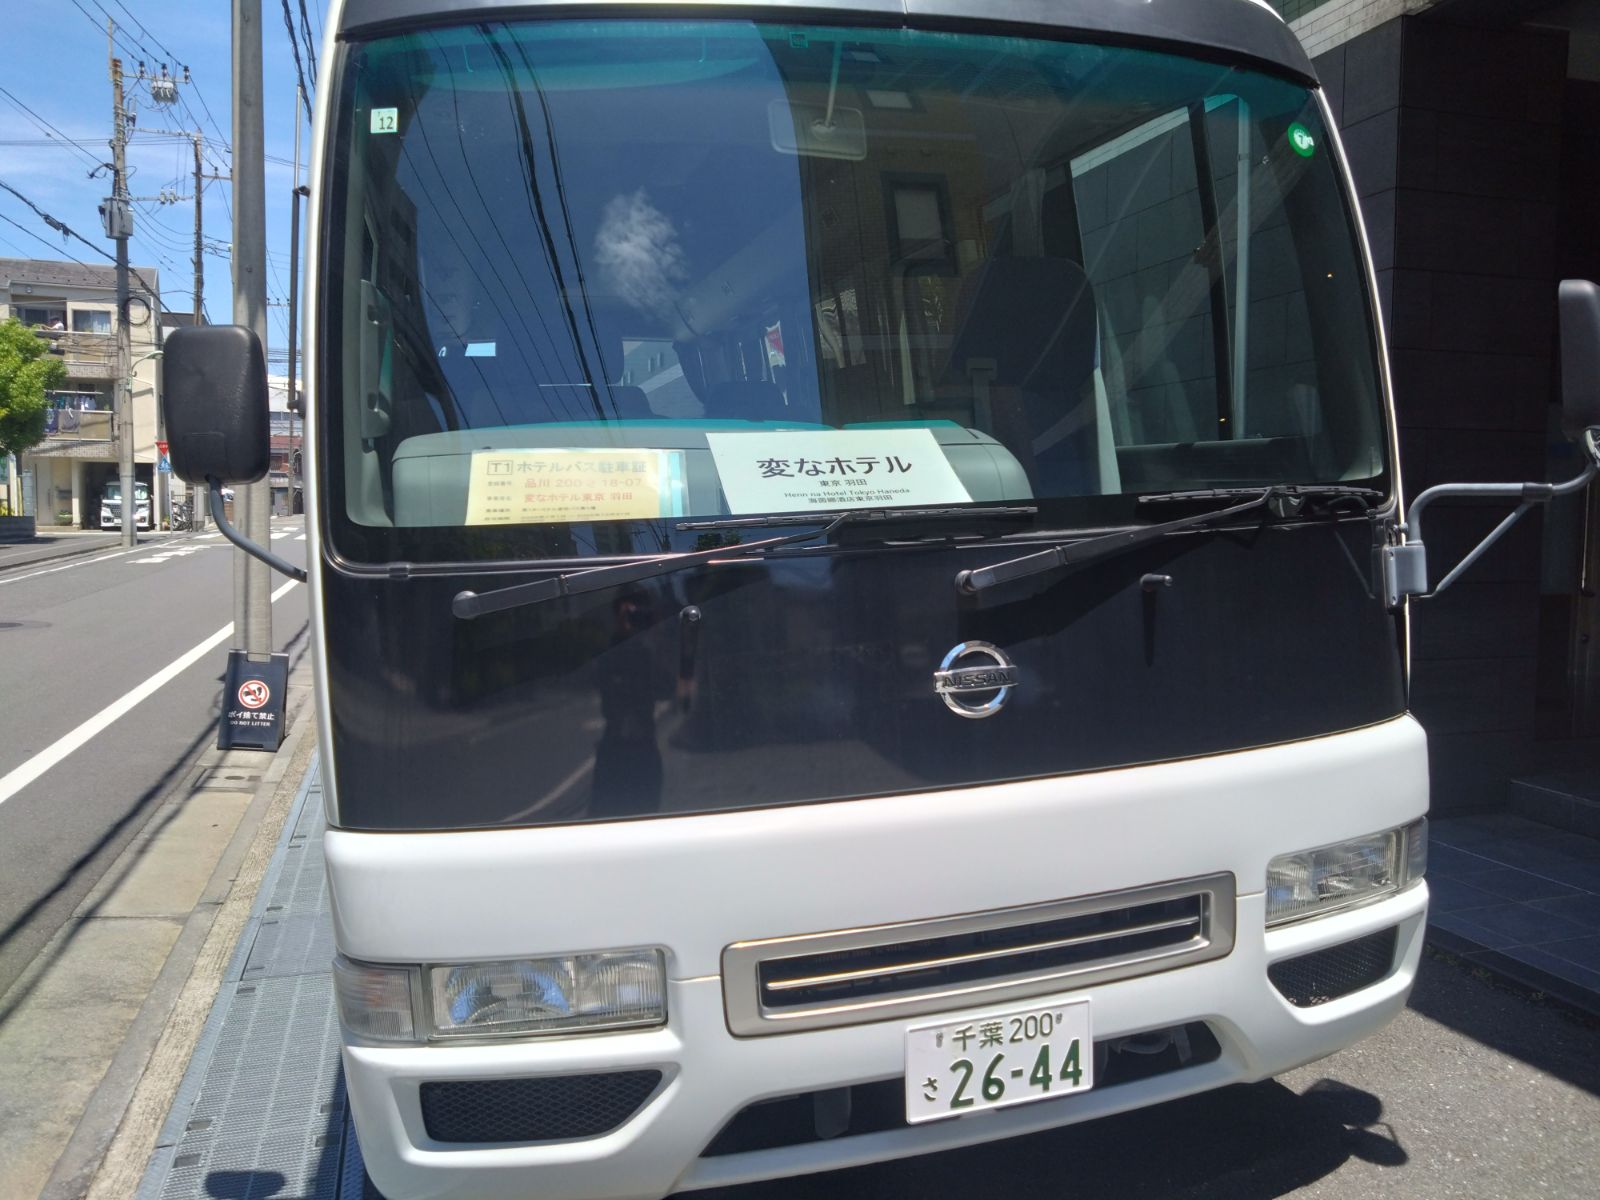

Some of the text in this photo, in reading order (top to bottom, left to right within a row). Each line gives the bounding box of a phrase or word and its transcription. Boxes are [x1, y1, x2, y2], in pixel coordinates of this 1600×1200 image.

[379, 116, 394, 130] 12
[491, 461, 647, 474] T1 ホテルバス駐車証
[756, 456, 912, 478] 変なホテル
[525, 478, 550, 488] 品川
[555, 478, 582, 488] 200
[602, 478, 643, 488] 18-07
[820, 479, 868, 488] 東京 羽田
[524, 493, 605, 503] 変なホテル東京
[943, 671, 1009, 688] NISSAN
[228, 711, 275, 720] ポイ捨て禁止
[952, 1012, 1053, 1051] 千葉 200
[922, 1038, 1083, 1109] さ 26-44
